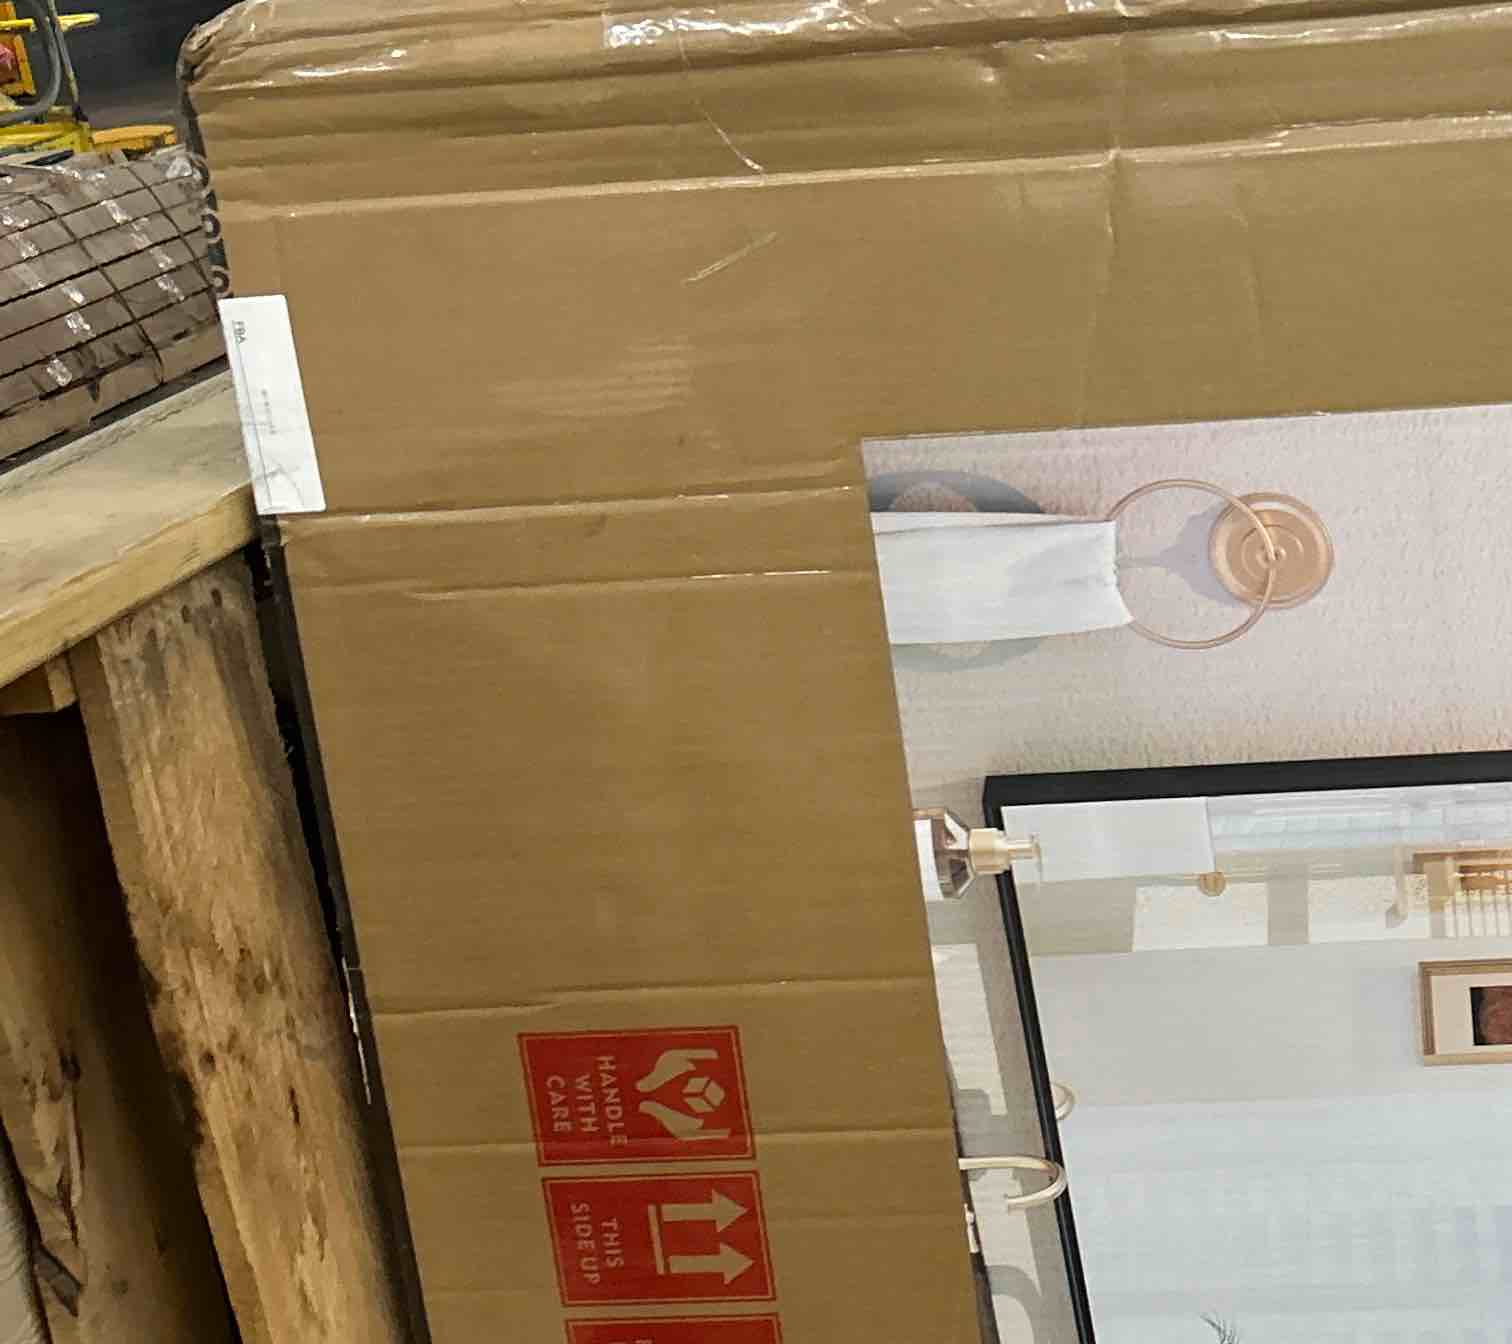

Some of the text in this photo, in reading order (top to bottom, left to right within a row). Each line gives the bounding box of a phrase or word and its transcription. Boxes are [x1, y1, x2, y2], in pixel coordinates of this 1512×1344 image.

[545, 1074, 571, 1133] CARE
[574, 1074, 598, 1133] WITH
[596, 1055, 628, 1145] HANDLE
[569, 1202, 600, 1285] SIDE UP
[600, 1216, 624, 1268] THIS
